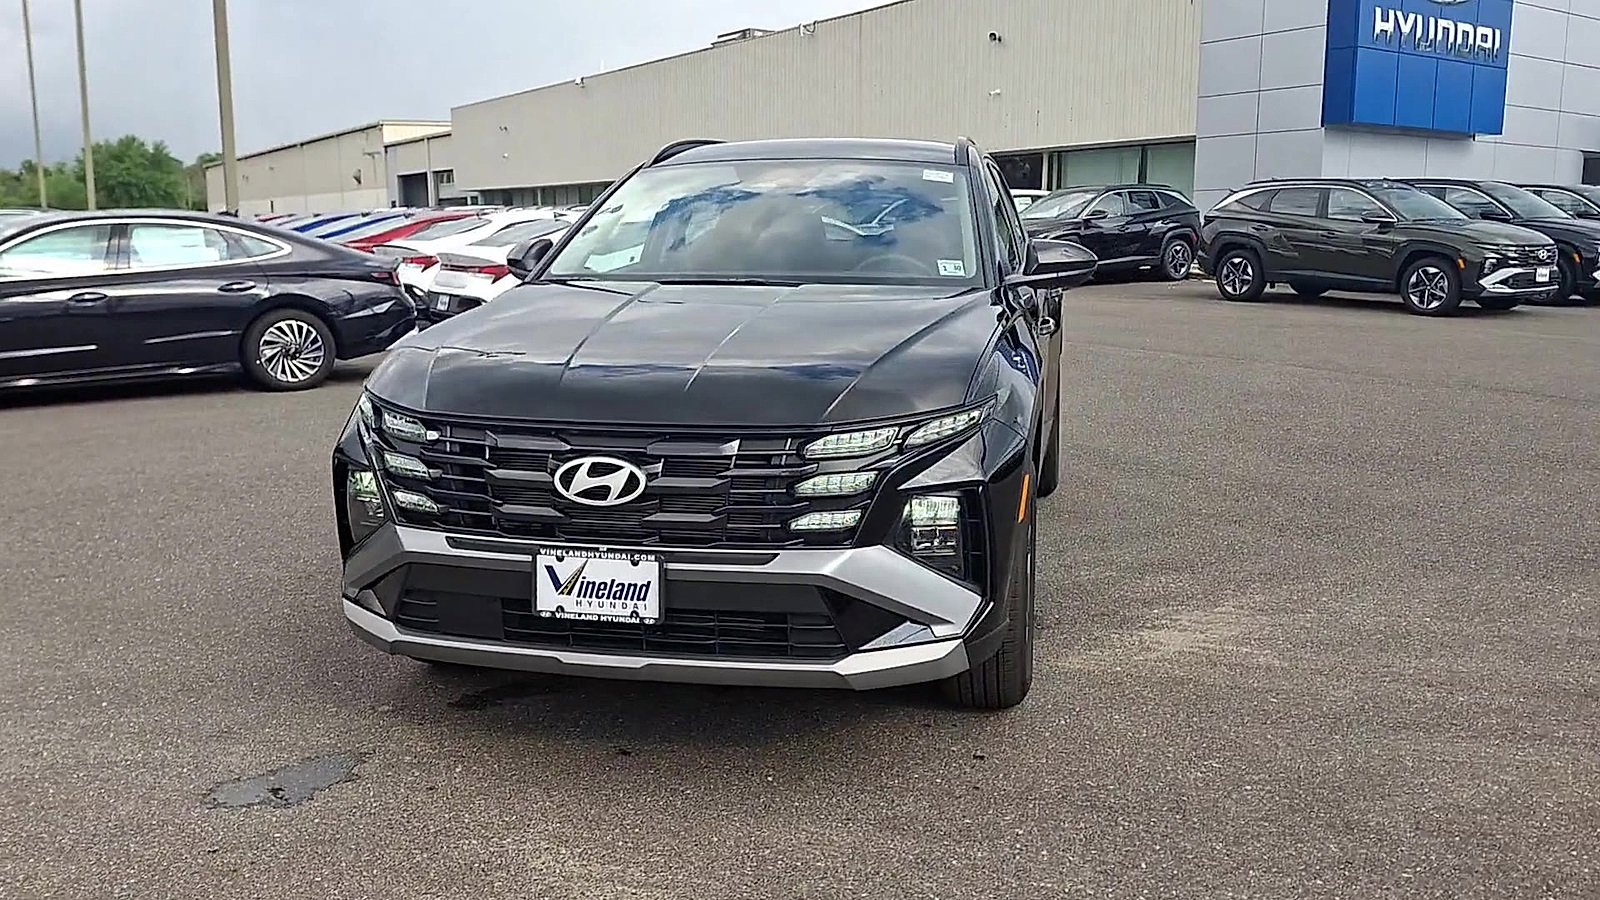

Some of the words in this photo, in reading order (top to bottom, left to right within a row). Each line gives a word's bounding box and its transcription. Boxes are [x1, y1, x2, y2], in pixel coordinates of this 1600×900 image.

[1373, 6, 1501, 62] HYUNDAI
[540, 548, 656, 561] VINELANDHYUNDAI.COM
[544, 558, 652, 602] Vineland
[575, 600, 648, 611] HYUNDAI
[555, 612, 599, 621] VINELAND
[600, 615, 640, 624] HYUNDAI
